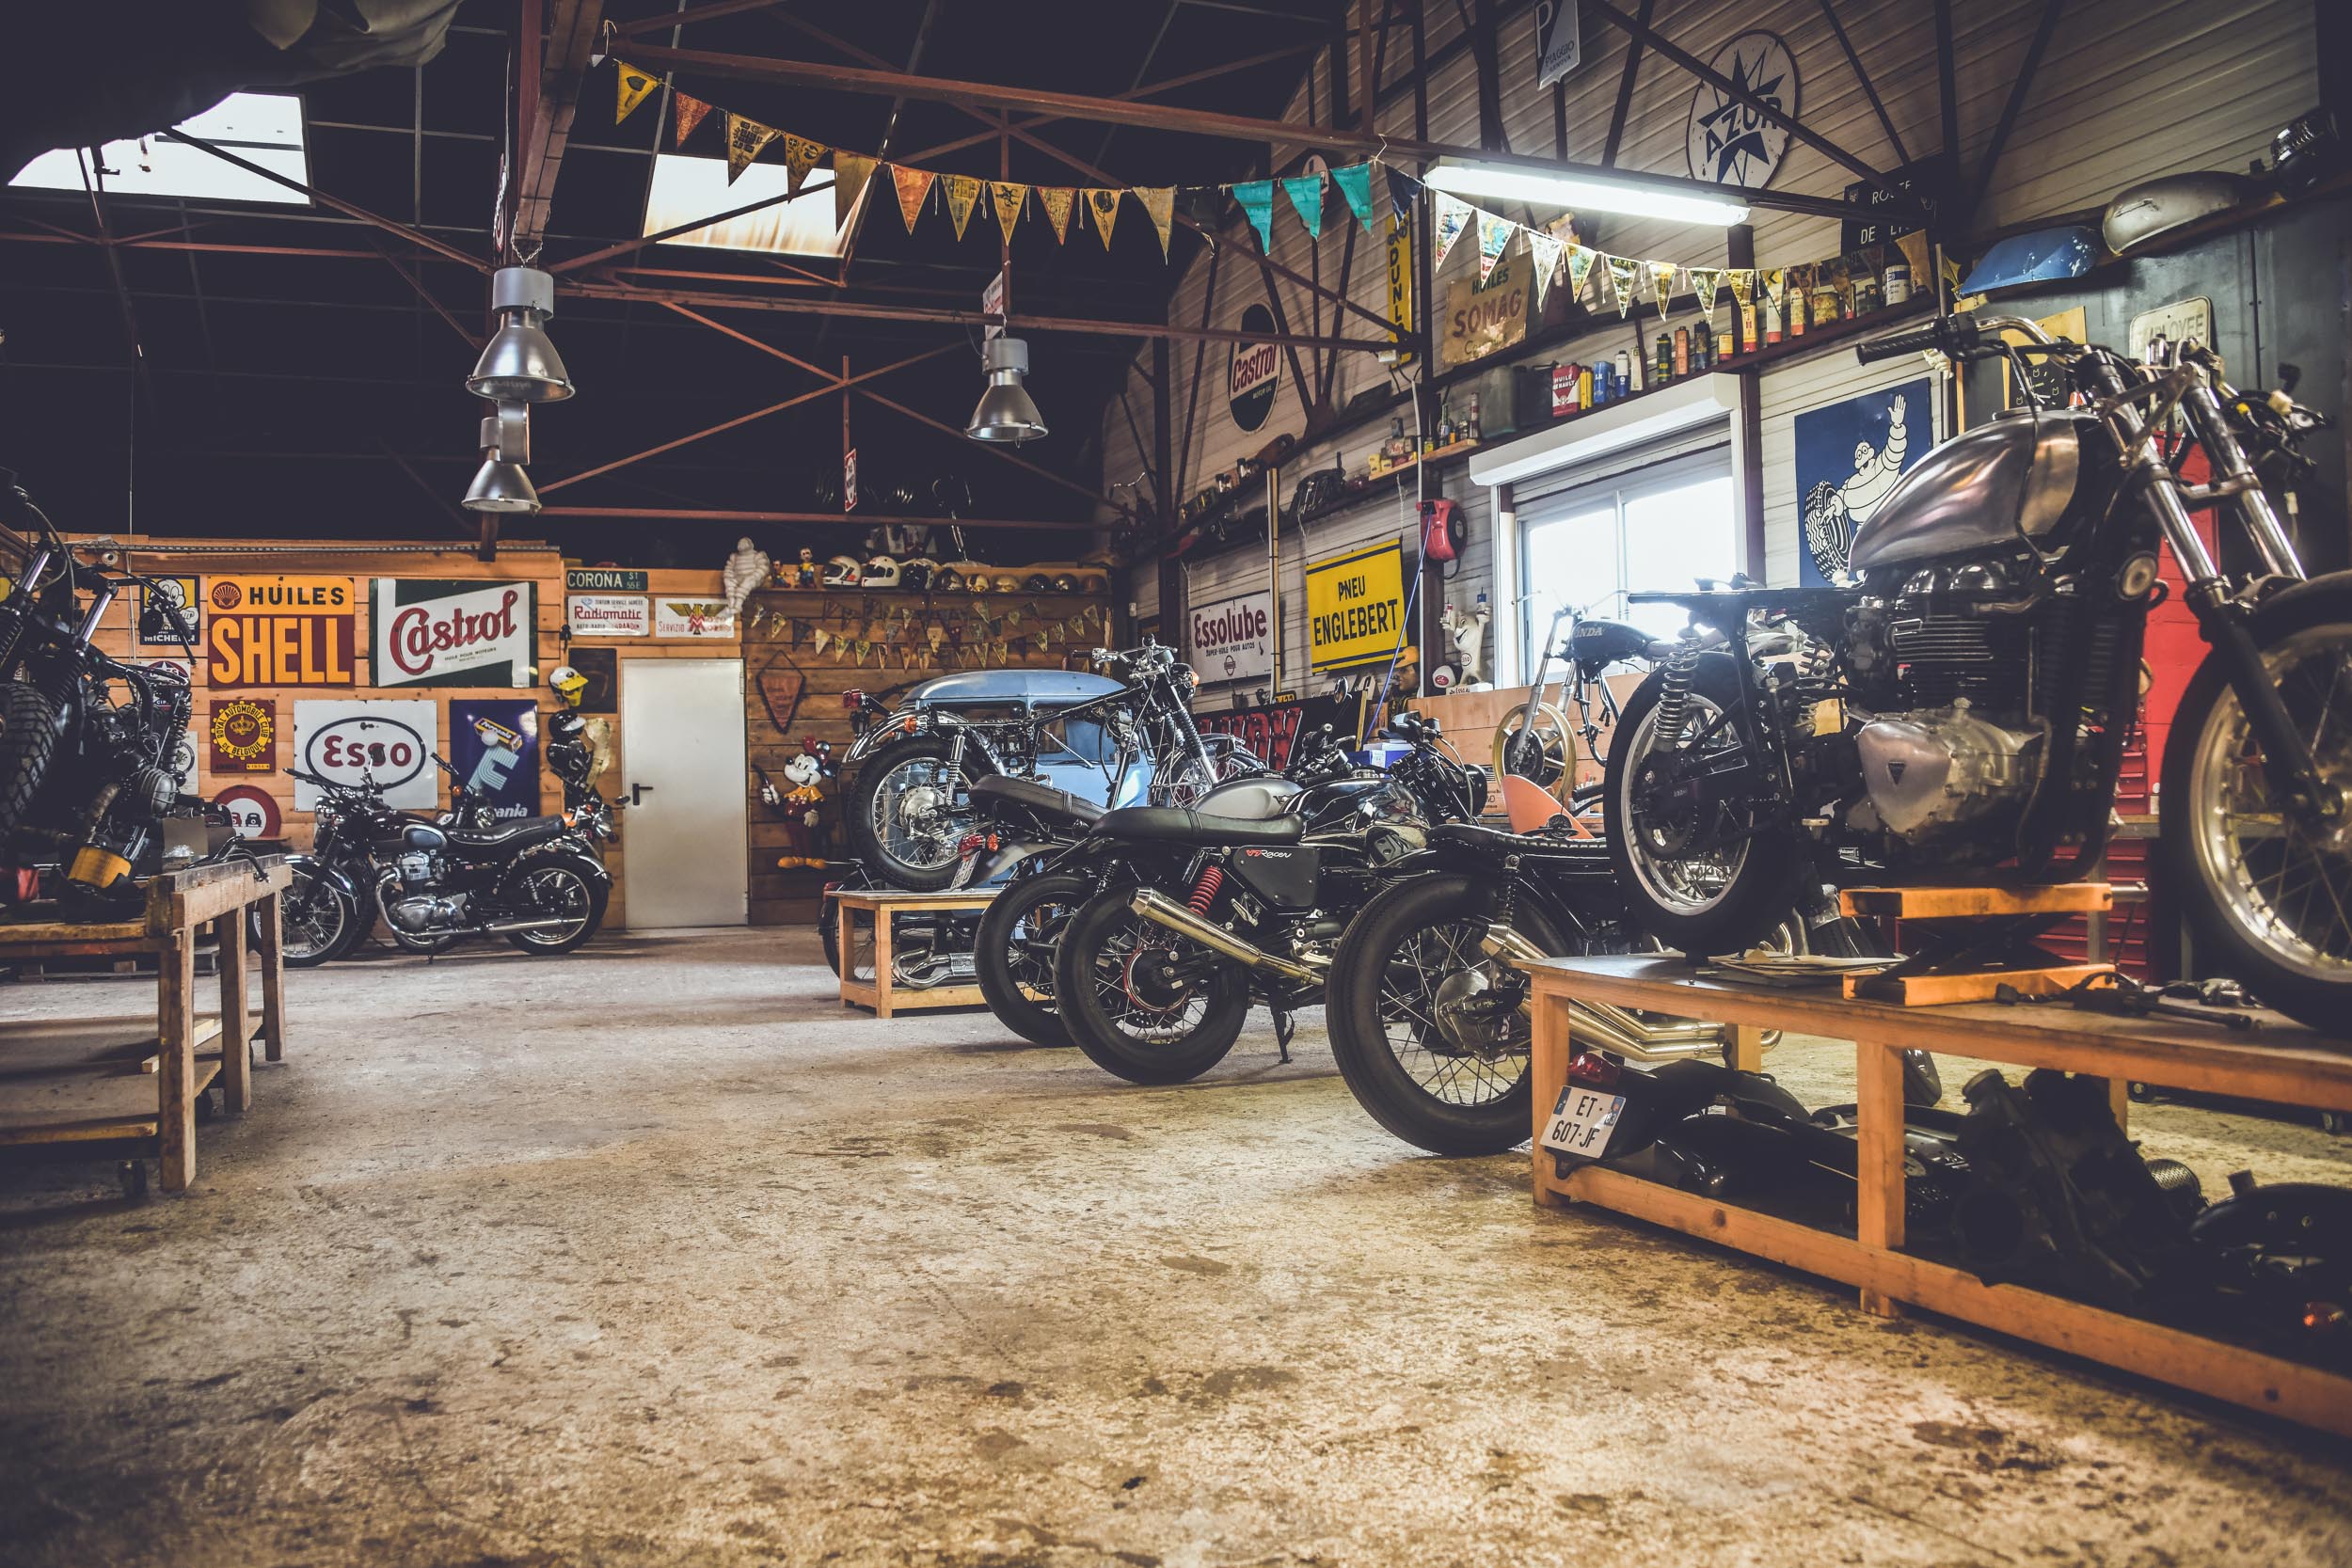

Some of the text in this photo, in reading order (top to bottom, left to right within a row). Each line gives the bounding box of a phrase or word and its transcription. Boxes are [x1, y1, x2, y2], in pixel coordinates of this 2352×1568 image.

[1545, 40, 1575, 67] PIAGGIO
[1706, 97, 1782, 164] AZUR
[1860, 225, 1876, 245] DE
[1452, 288, 1522, 339] SOMAG
[1232, 343, 1277, 393] Castrol
[567, 572, 623, 588] CORONA
[1338, 575, 1366, 602] PNEU
[249, 586, 344, 606] HUILES
[574, 606, 643, 620] Radiomatic
[1194, 605, 1267, 649] Essolube
[1313, 598, 1398, 646] ENGLEBERT
[389, 590, 518, 675] Castrol
[212, 617, 351, 684] SHELL
[1230, 643, 1241, 653] POUR
[216, 705, 268, 739] ROYAL AUTOMOBILE CLUB
[231, 742, 263, 755] BELGIQUE
[323, 735, 412, 768] Esso
[1261, 849, 1292, 859] Racer
